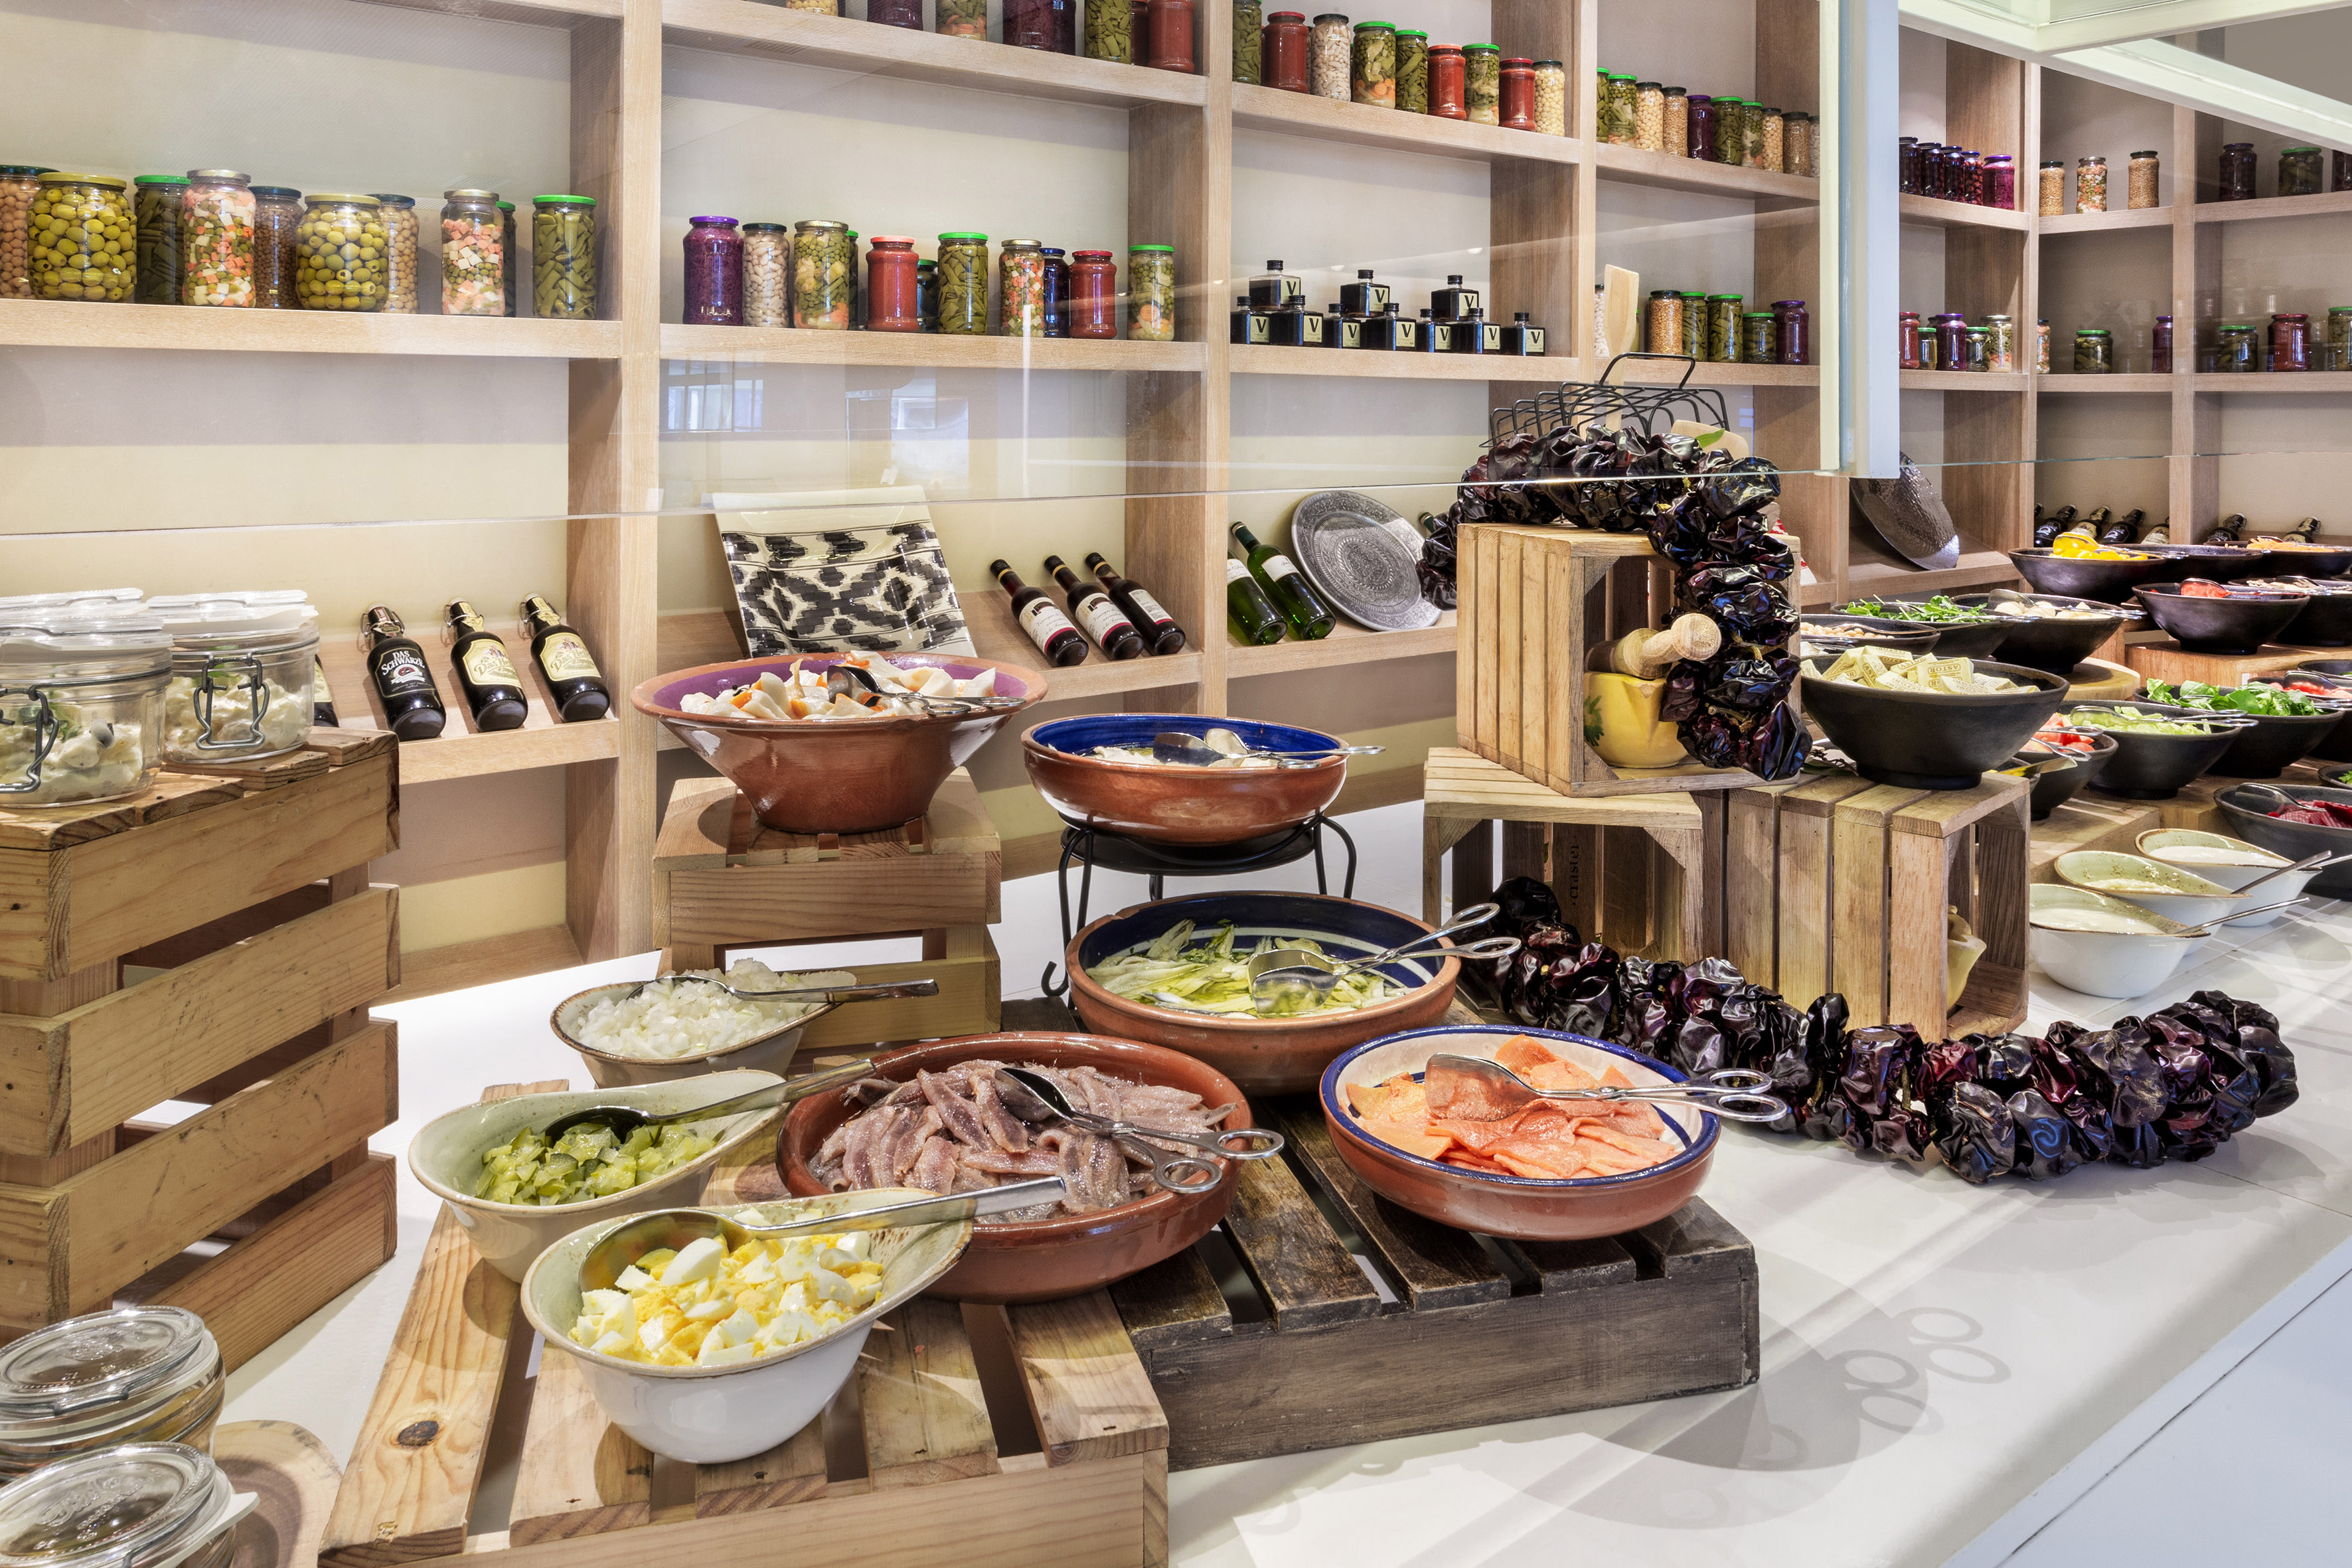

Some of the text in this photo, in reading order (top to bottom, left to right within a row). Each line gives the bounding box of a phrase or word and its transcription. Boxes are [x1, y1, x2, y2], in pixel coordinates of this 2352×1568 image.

[1287, 281, 1296, 295] V
[1375, 289, 1385, 303] V
[1464, 295, 1474, 308] V
[1255, 319, 1267, 333] V
[1309, 318, 1319, 333] V
[1348, 325, 1357, 339] V
[1401, 324, 1411, 338] V
[1440, 328, 1449, 341] V
[1488, 327, 1497, 341] V
[1531, 331, 1540, 344] V
[392, 651, 410, 659] DAS
[381, 657, 426, 676] SCHWARZE
[550, 653, 572, 672] Das
